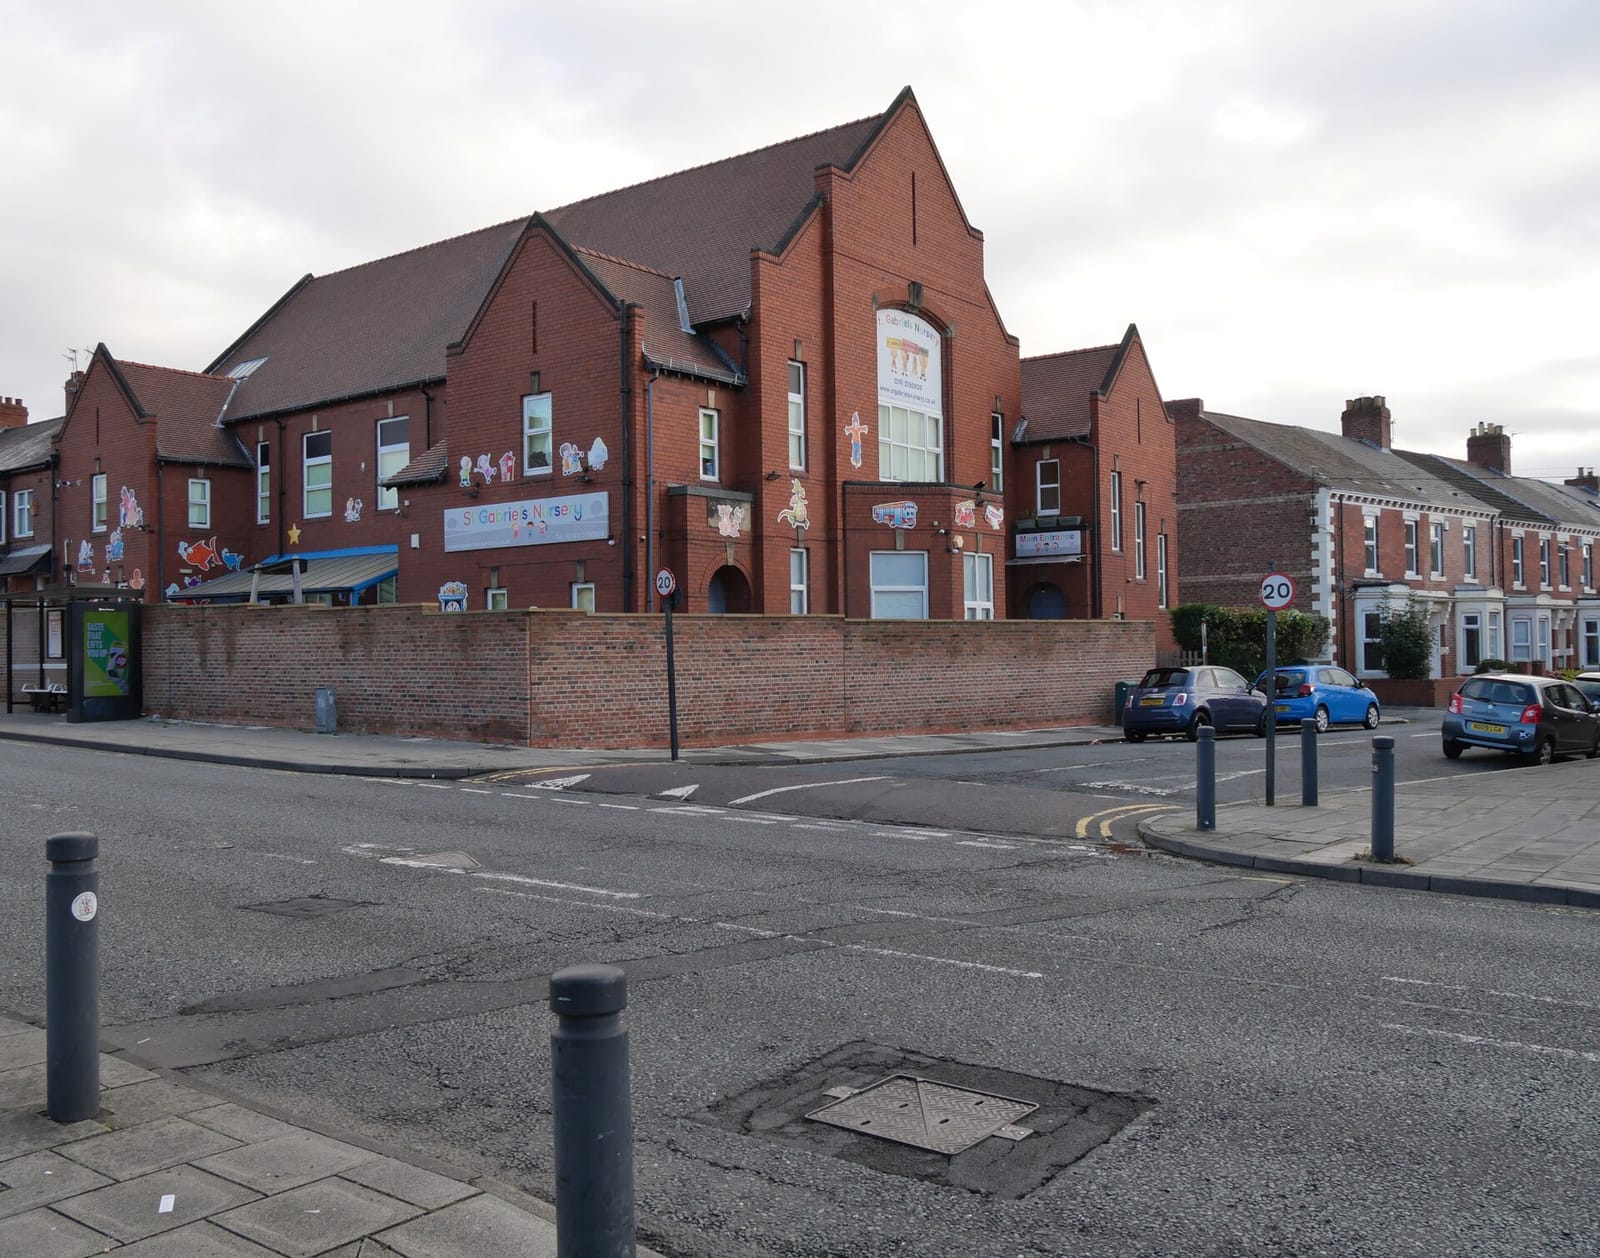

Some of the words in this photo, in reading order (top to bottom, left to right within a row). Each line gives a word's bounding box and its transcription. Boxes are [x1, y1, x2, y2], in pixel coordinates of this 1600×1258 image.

[916, 322, 940, 346] Nursery
[534, 504, 583, 522] Nursery
[658, 577, 670, 588] 20
[1264, 583, 1290, 599] 20
